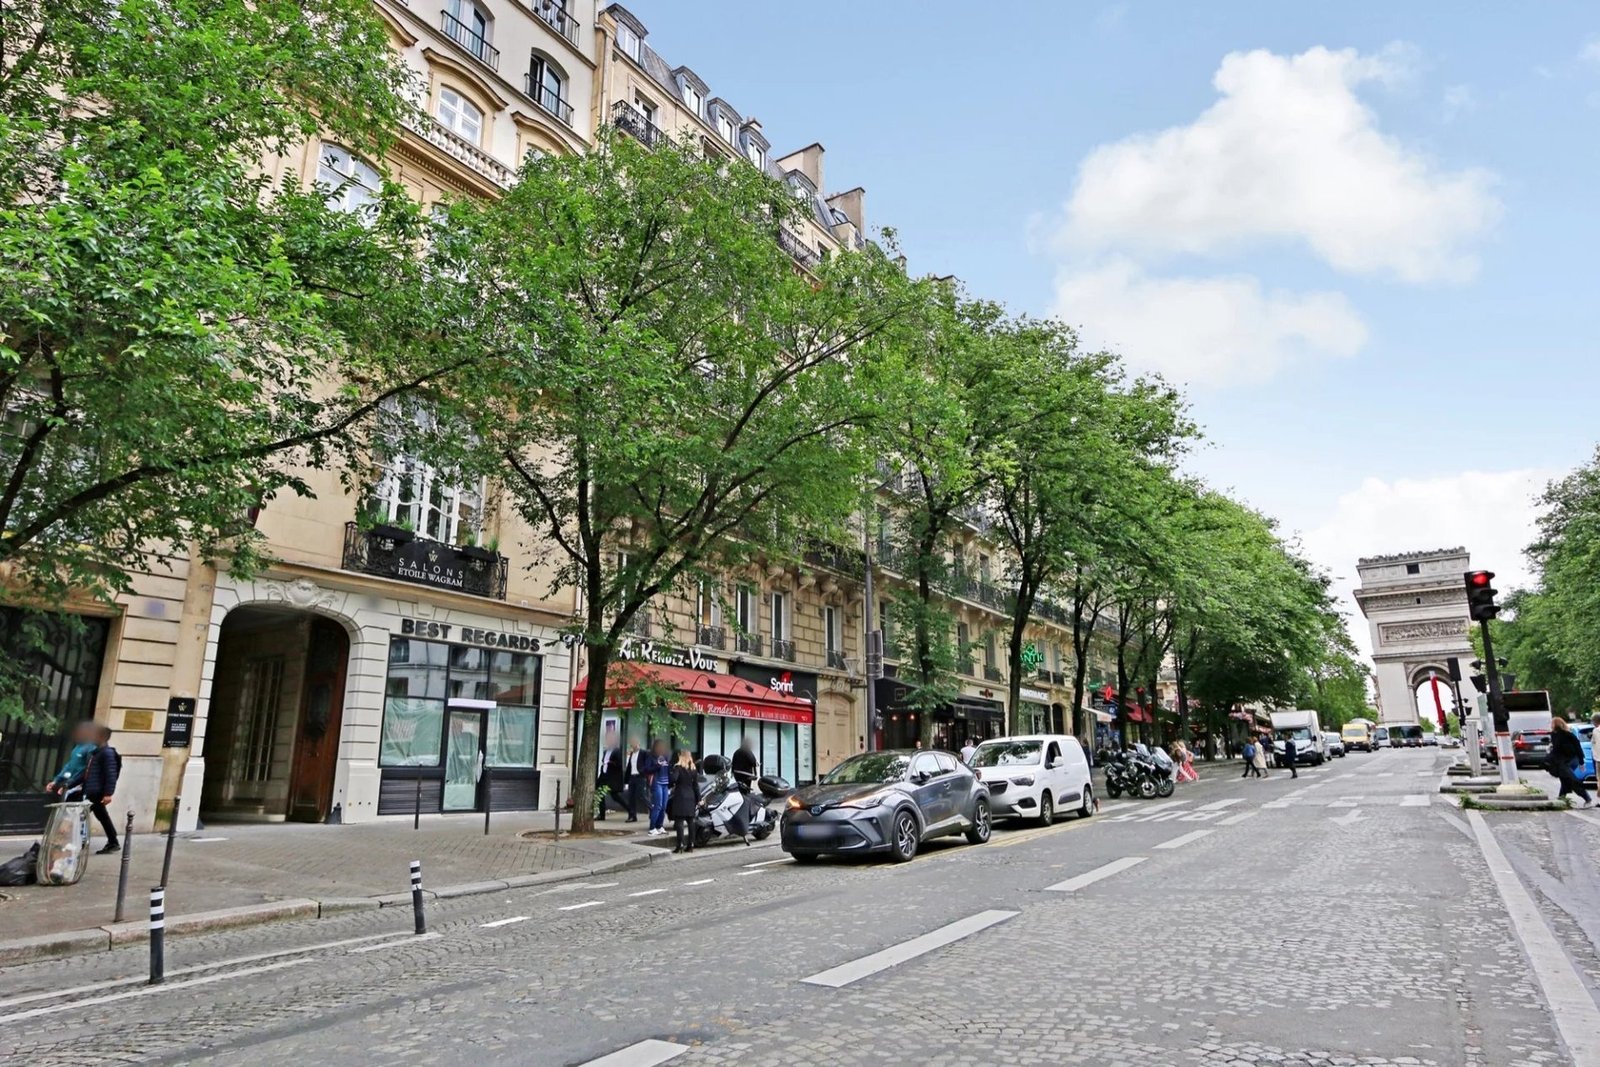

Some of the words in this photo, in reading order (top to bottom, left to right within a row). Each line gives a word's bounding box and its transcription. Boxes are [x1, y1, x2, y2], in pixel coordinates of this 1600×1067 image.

[398, 567, 427, 580] ETOILE
[428, 572, 463, 588] WAGRAM
[399, 557, 464, 579] SALONS
[401, 618, 452, 640] BEST
[461, 627, 540, 651] REGARDS
[770, 677, 794, 693] Sprint
